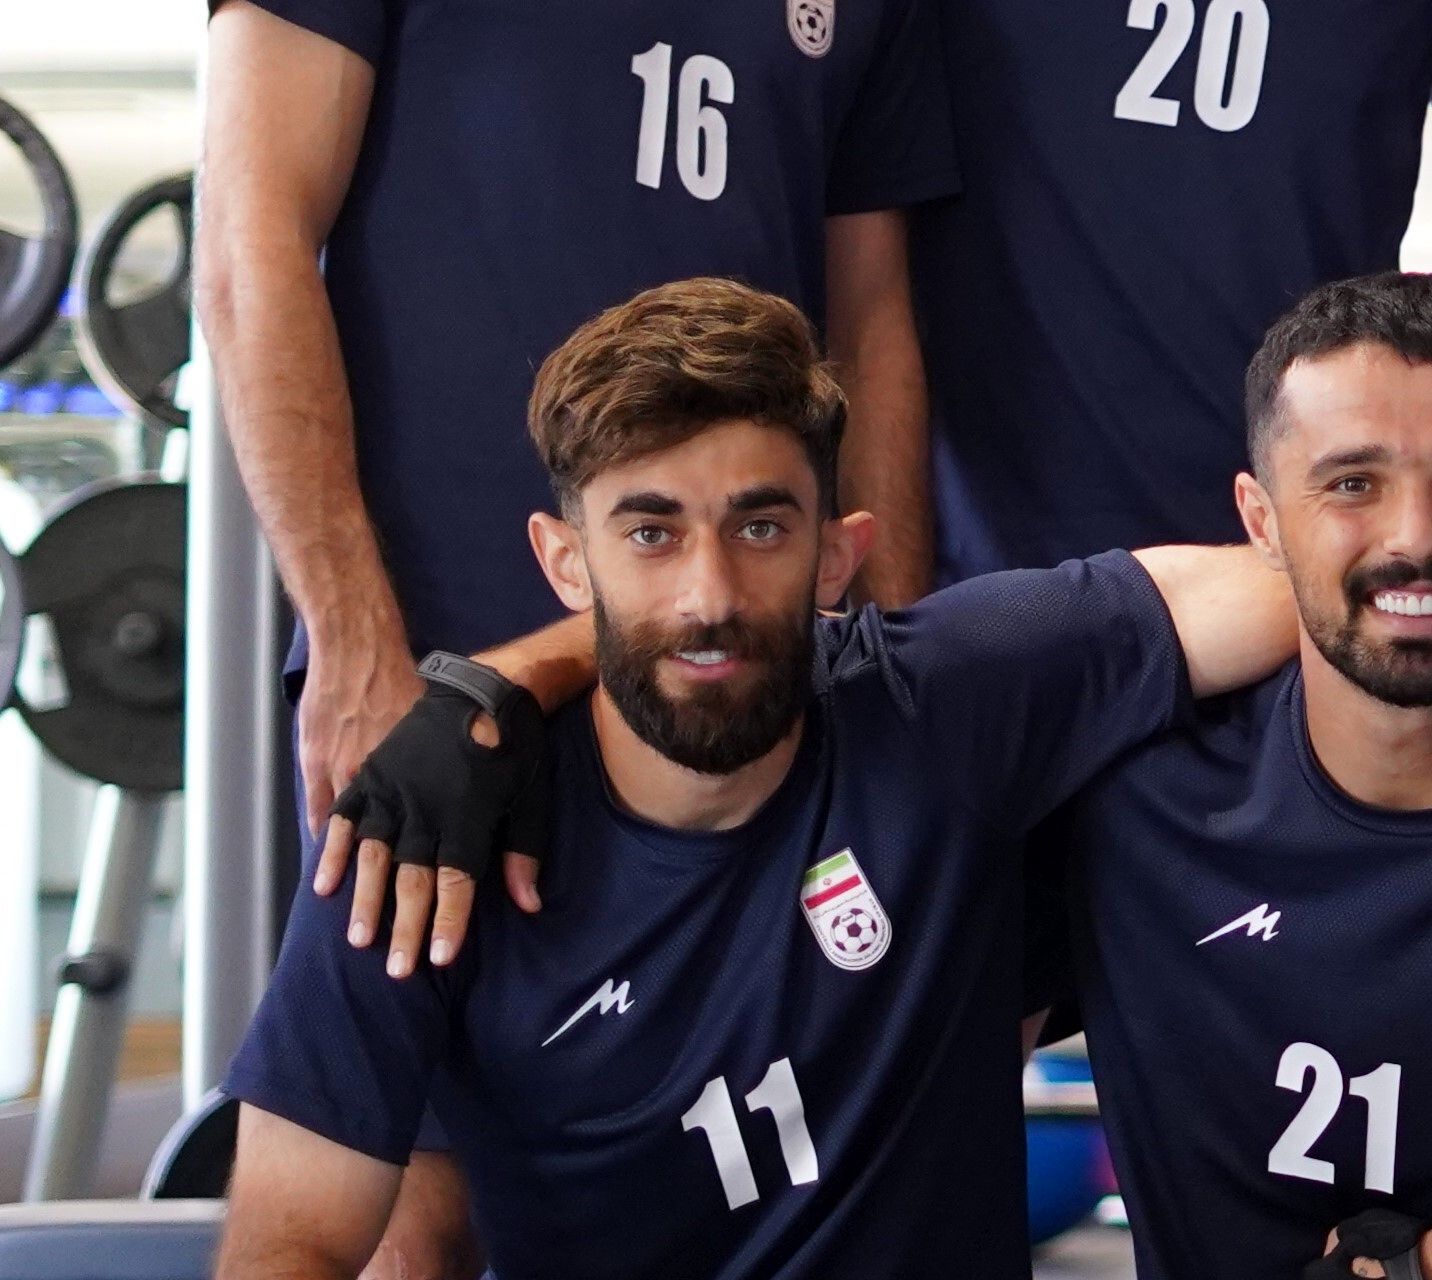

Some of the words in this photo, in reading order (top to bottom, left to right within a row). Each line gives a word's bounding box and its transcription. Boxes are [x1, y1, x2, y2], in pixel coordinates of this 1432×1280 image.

[631, 41, 735, 201] 16
[680, 1057, 819, 1211] 11
[1267, 1041, 1402, 1195] 21
